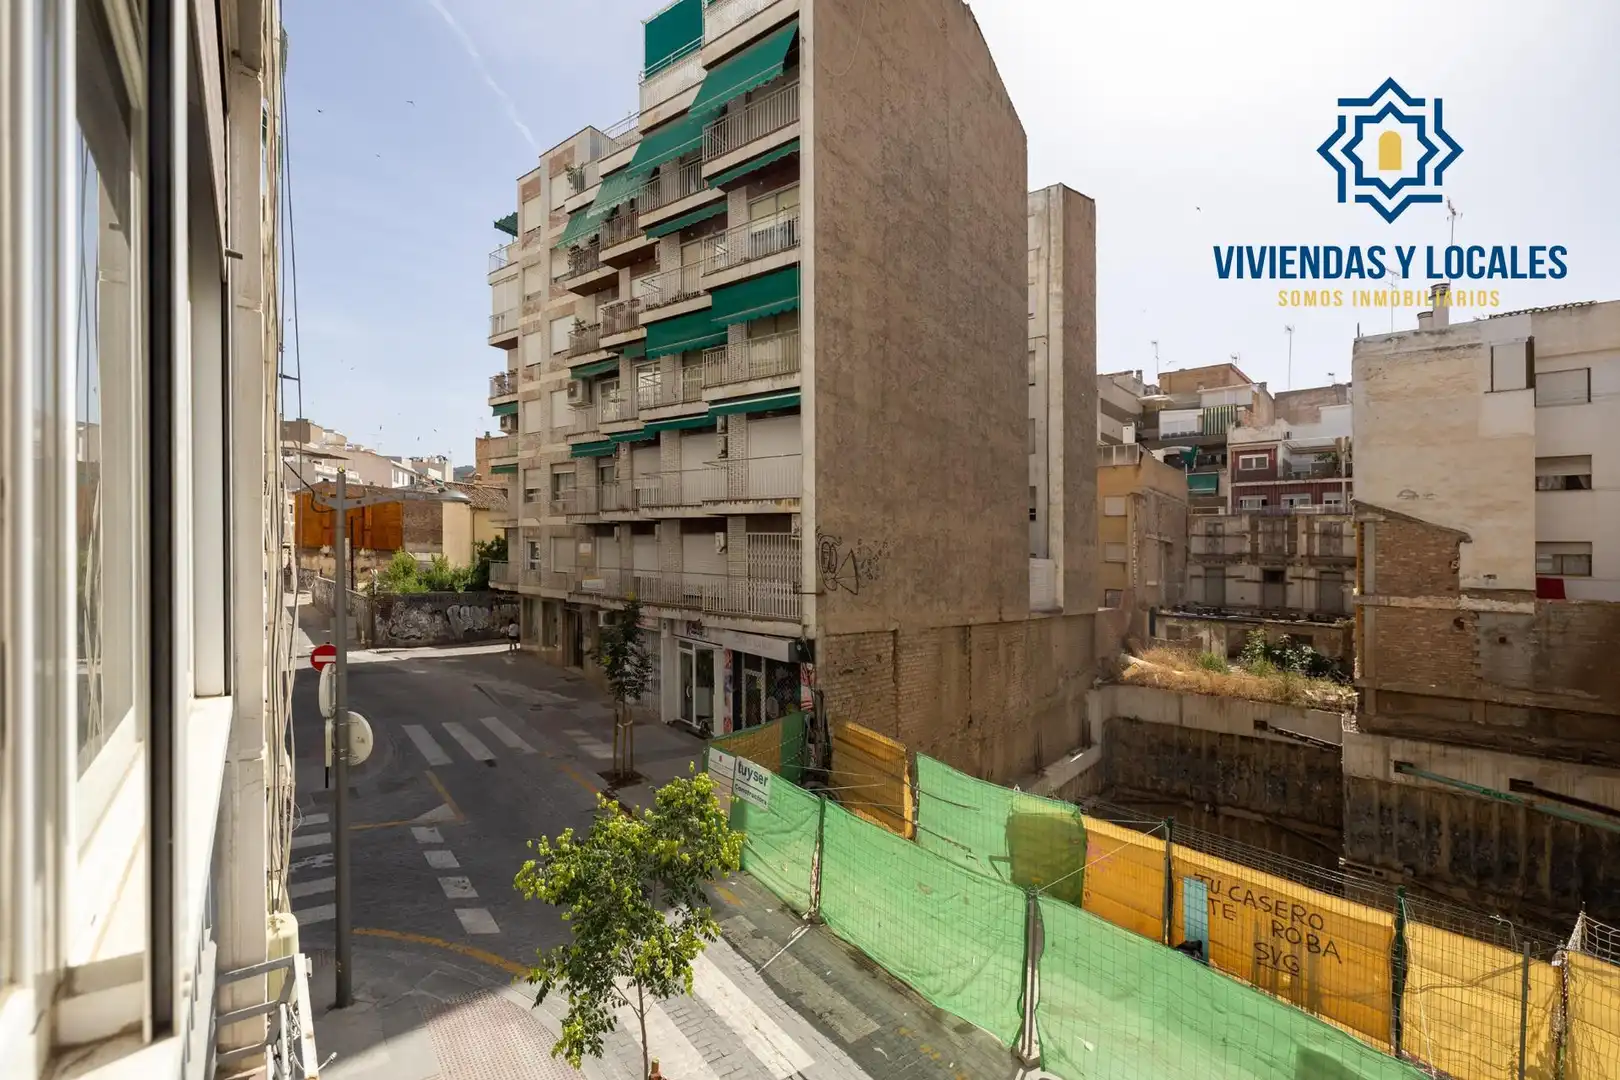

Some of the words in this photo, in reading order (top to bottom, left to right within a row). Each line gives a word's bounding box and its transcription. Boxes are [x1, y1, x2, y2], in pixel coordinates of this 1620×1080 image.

[737, 760, 768, 787] tuyser
[1194, 871, 1221, 895] TU
[1228, 886, 1324, 930] CASERO
[1208, 897, 1237, 921] TE
[1271, 919, 1342, 964] ROBA
